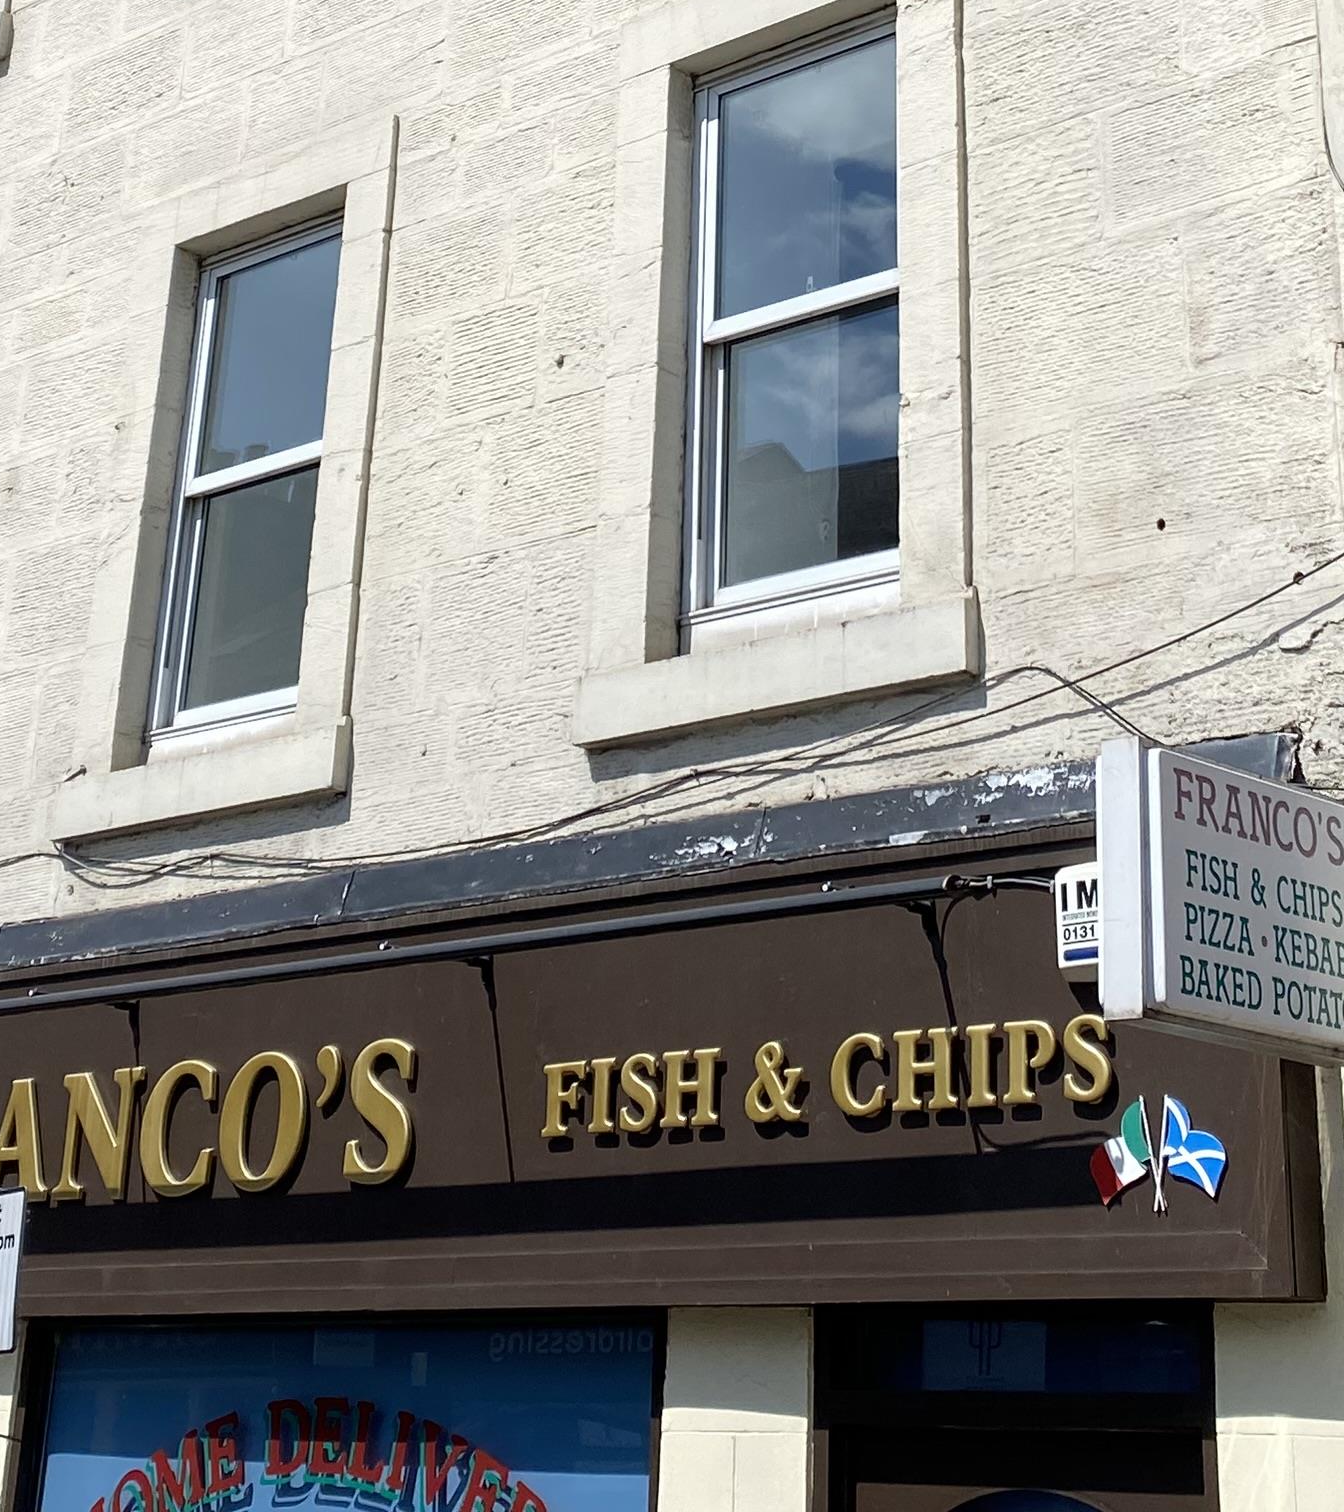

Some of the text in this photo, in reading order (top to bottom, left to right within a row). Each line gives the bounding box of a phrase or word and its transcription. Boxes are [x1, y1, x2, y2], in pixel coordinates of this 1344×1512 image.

[1185, 849, 1344, 928] FISH & CHIPS
[1063, 925, 1095, 941] 0131
[1184, 902, 1254, 956] PIZZA
[1180, 955, 1262, 1010] BAKED
[540, 1013, 1113, 1138] FISH & CHIPS
[90, 1410, 245, 1512] OME
